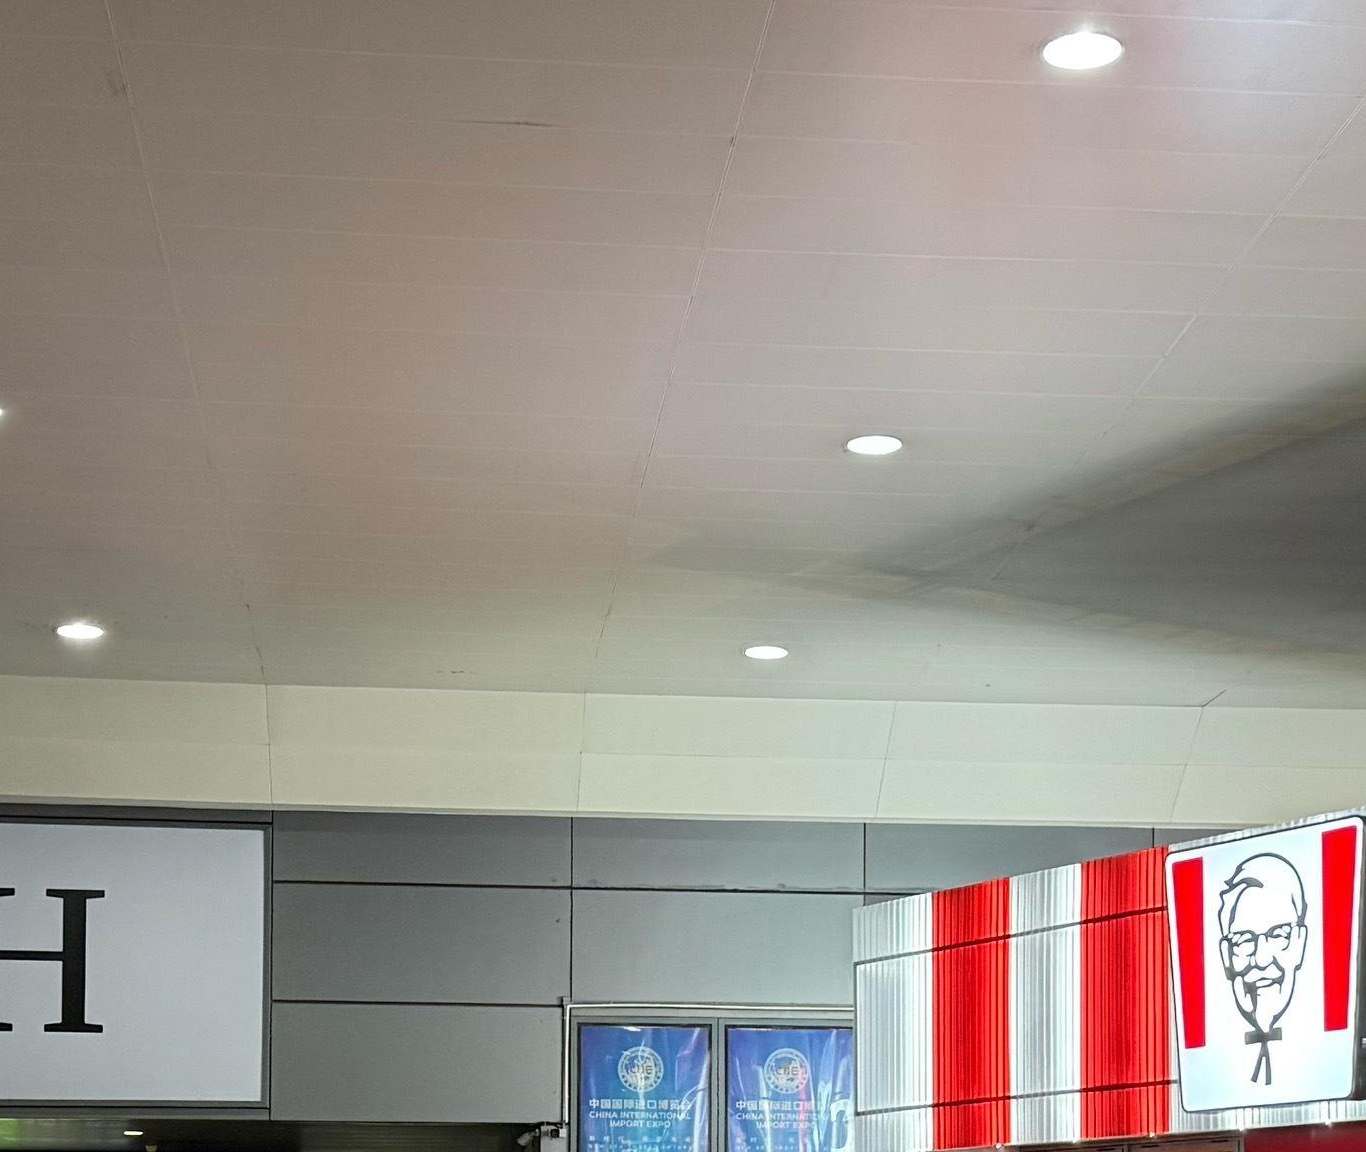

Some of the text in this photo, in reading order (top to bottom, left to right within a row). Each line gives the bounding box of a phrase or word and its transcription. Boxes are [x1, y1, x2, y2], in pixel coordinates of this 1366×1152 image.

[589, 1111, 617, 1119] CHINA
[609, 1120, 672, 1128] IMPORT EXPO
